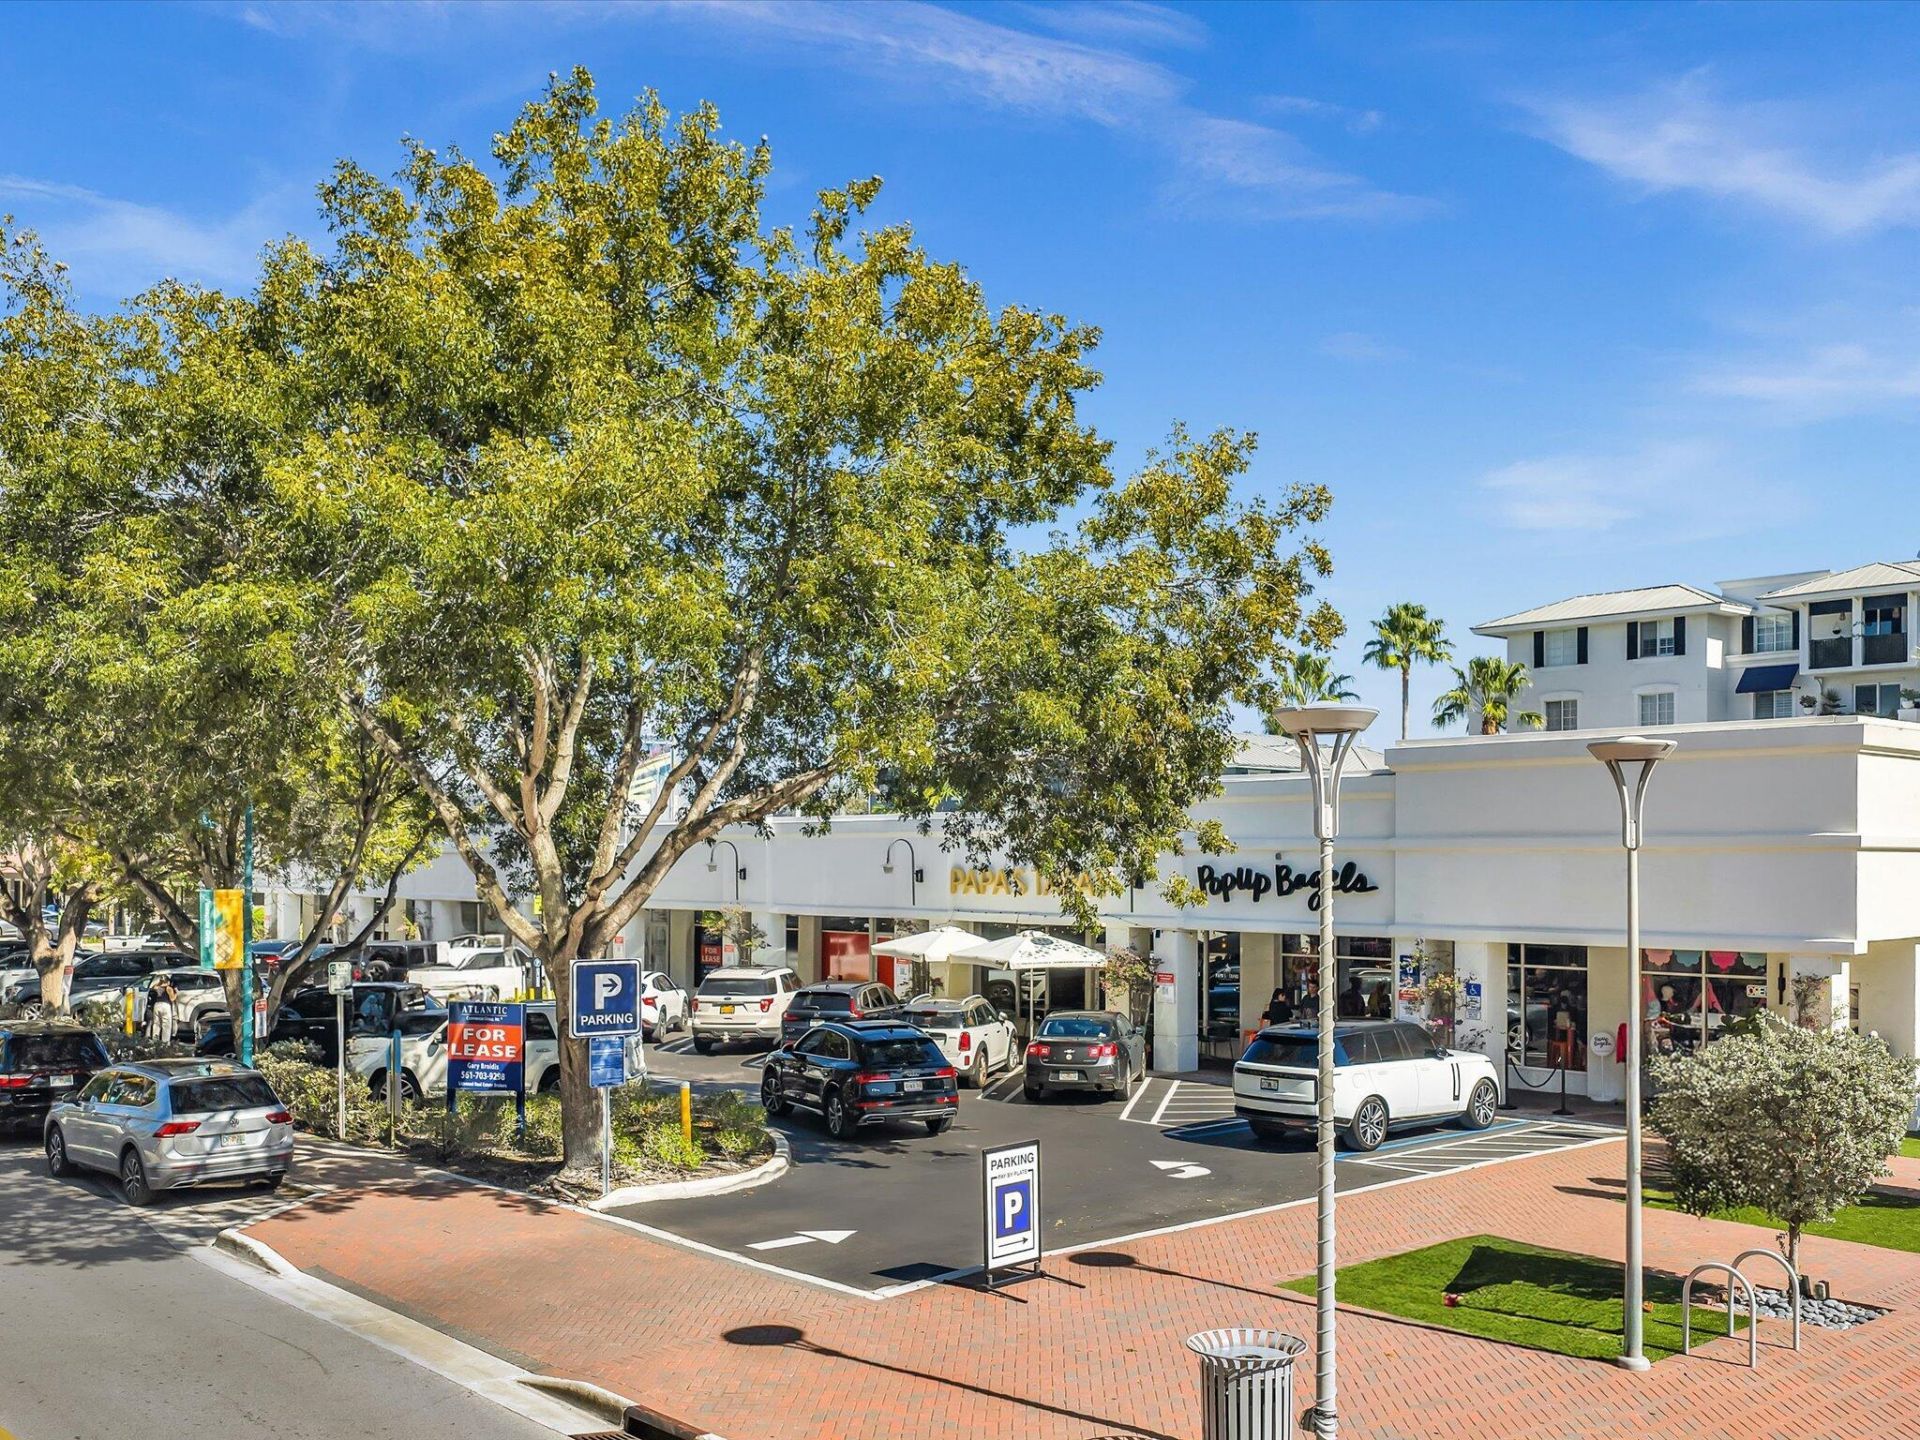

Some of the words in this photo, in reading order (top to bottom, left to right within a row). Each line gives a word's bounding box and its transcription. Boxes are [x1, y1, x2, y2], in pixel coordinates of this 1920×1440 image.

[950, 867, 1029, 896] PAPAS
[701, 955, 720, 963] LEASE
[461, 1005, 508, 1015] ATLANTIC
[580, 1012, 634, 1026] PARKING
[463, 1028, 506, 1042] FOR
[450, 1043, 517, 1058] LEASE
[467, 1062, 480, 1070] Gary
[991, 1152, 1034, 1170] PARKING
[1013, 1168, 1028, 1177] PLATE
[1004, 1191, 1023, 1229] P
